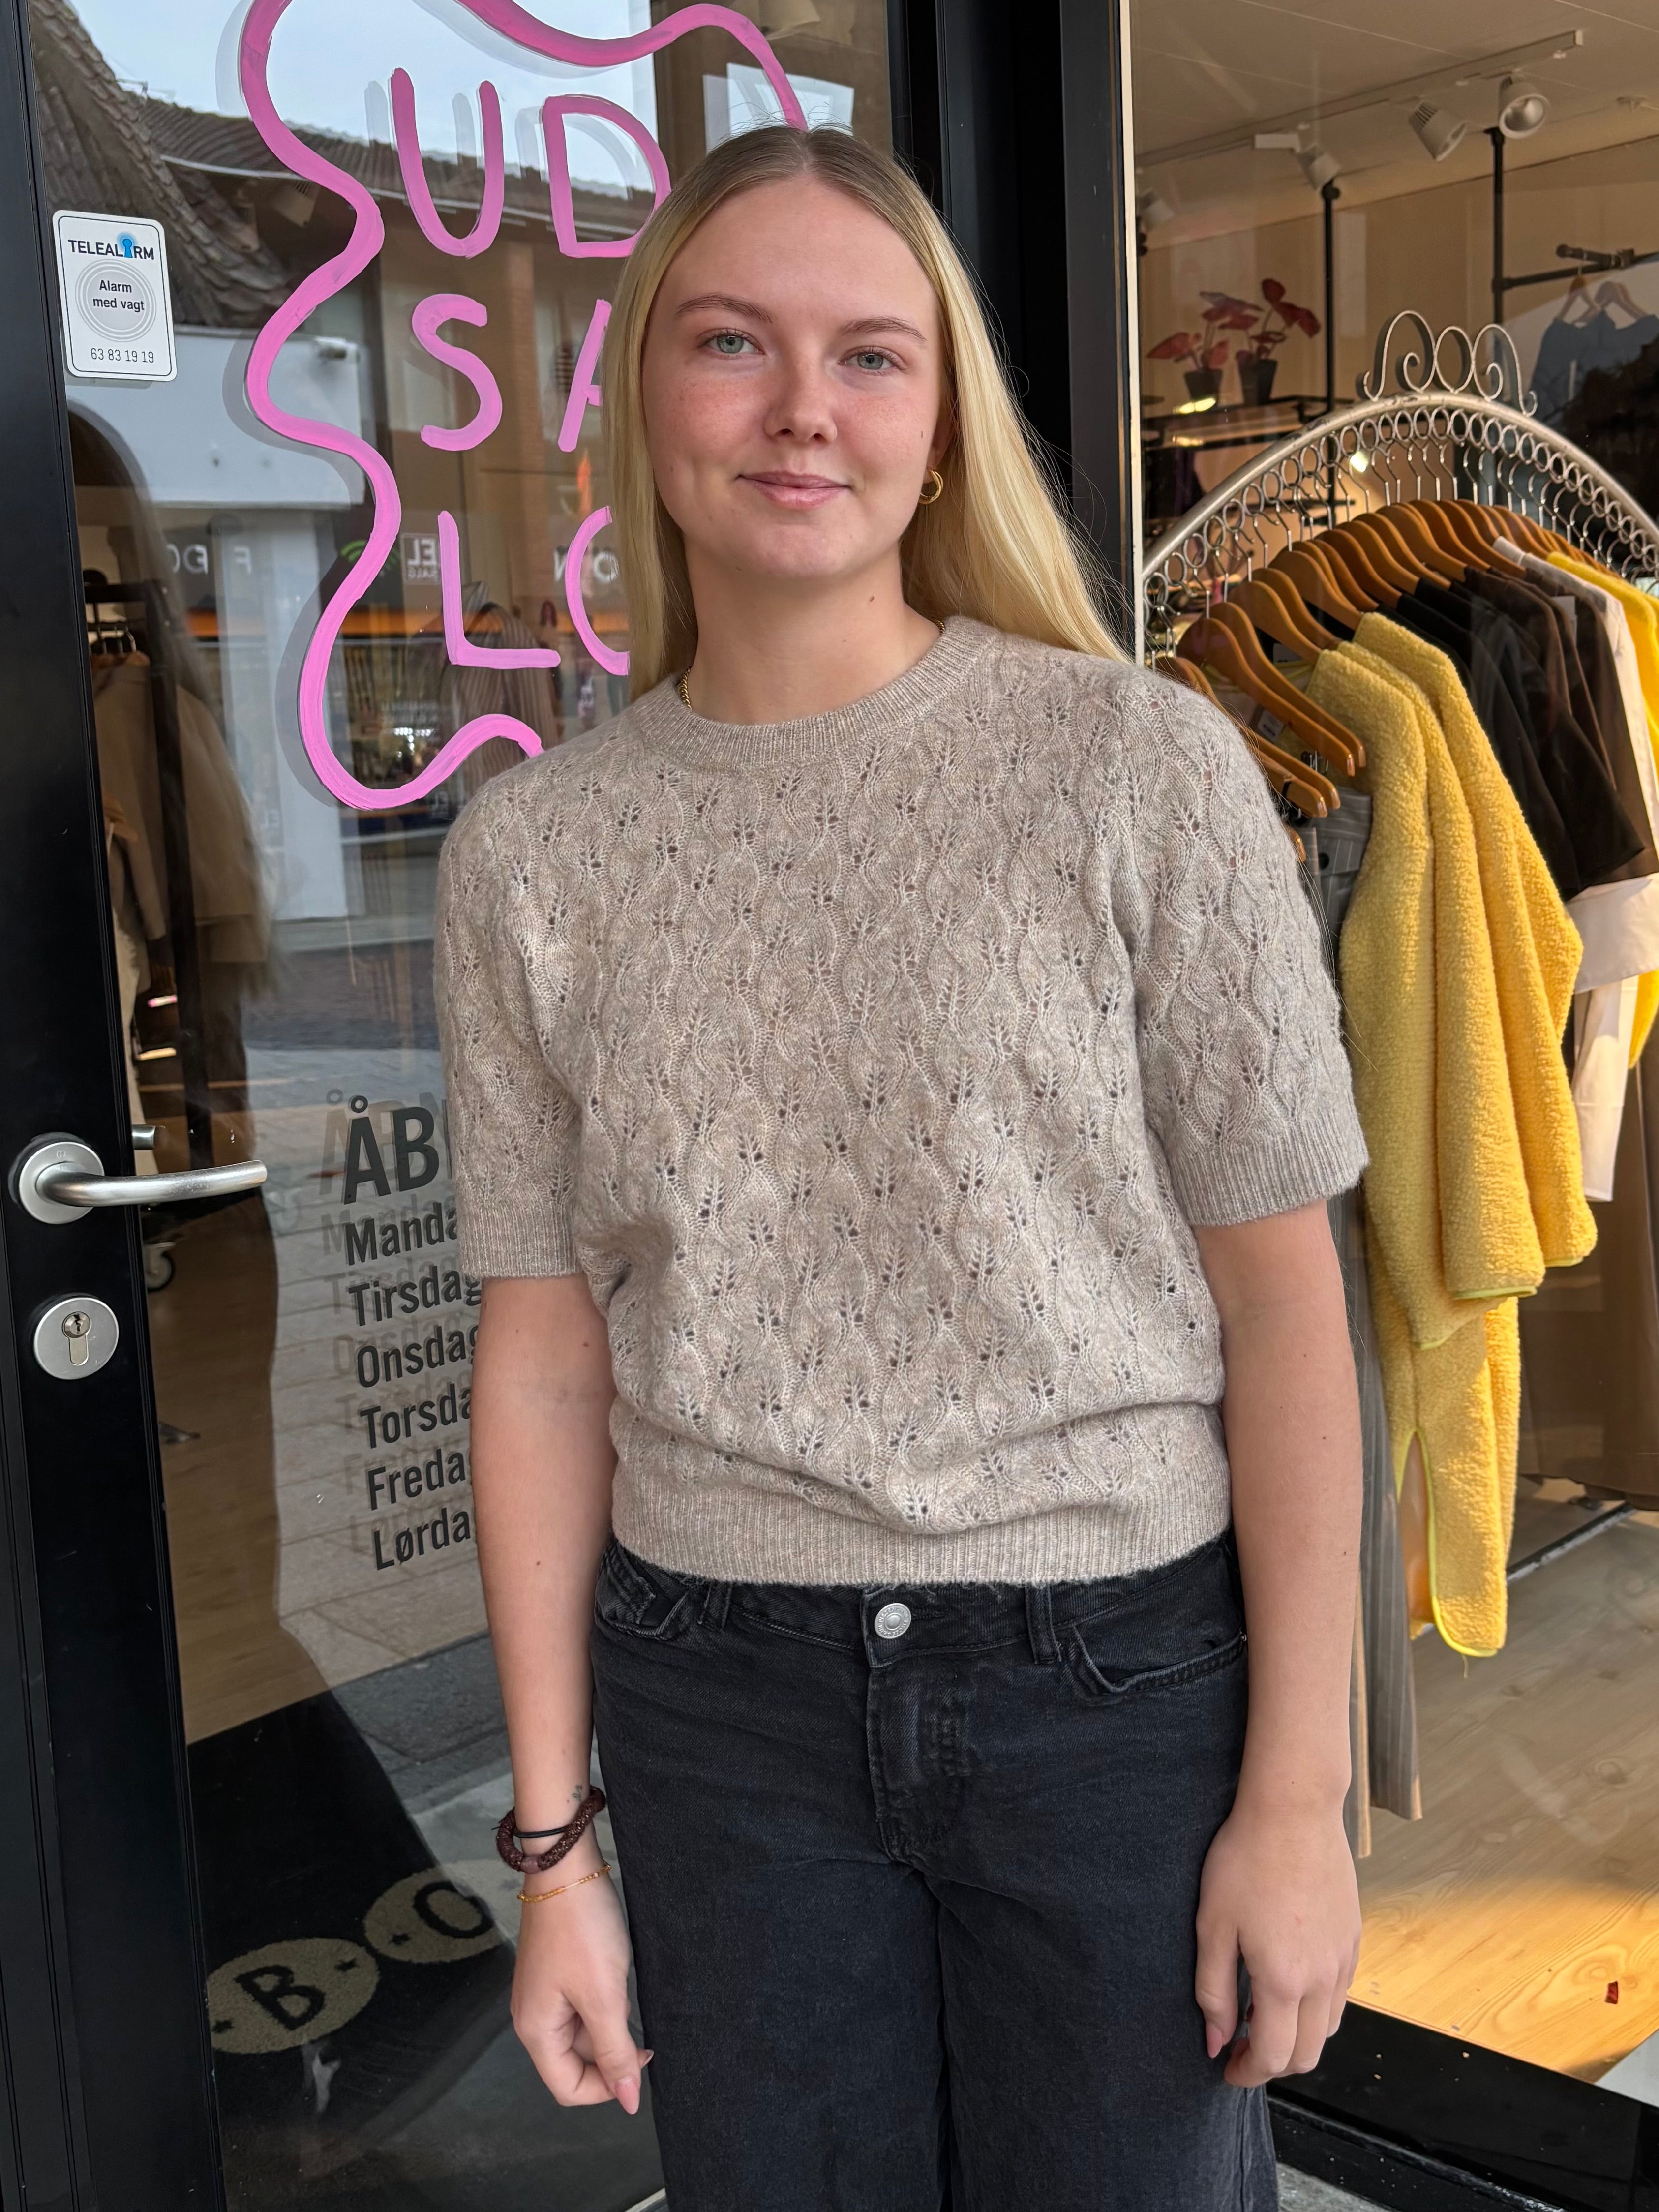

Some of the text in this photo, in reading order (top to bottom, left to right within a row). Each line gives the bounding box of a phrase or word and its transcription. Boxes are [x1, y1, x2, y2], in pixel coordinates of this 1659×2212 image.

[99, 280, 132, 293] Alarm
[93, 297, 145, 312] med vagt
[90, 348, 154, 364] 63 83 19 19
[343, 1095, 453, 1205] ÅB
